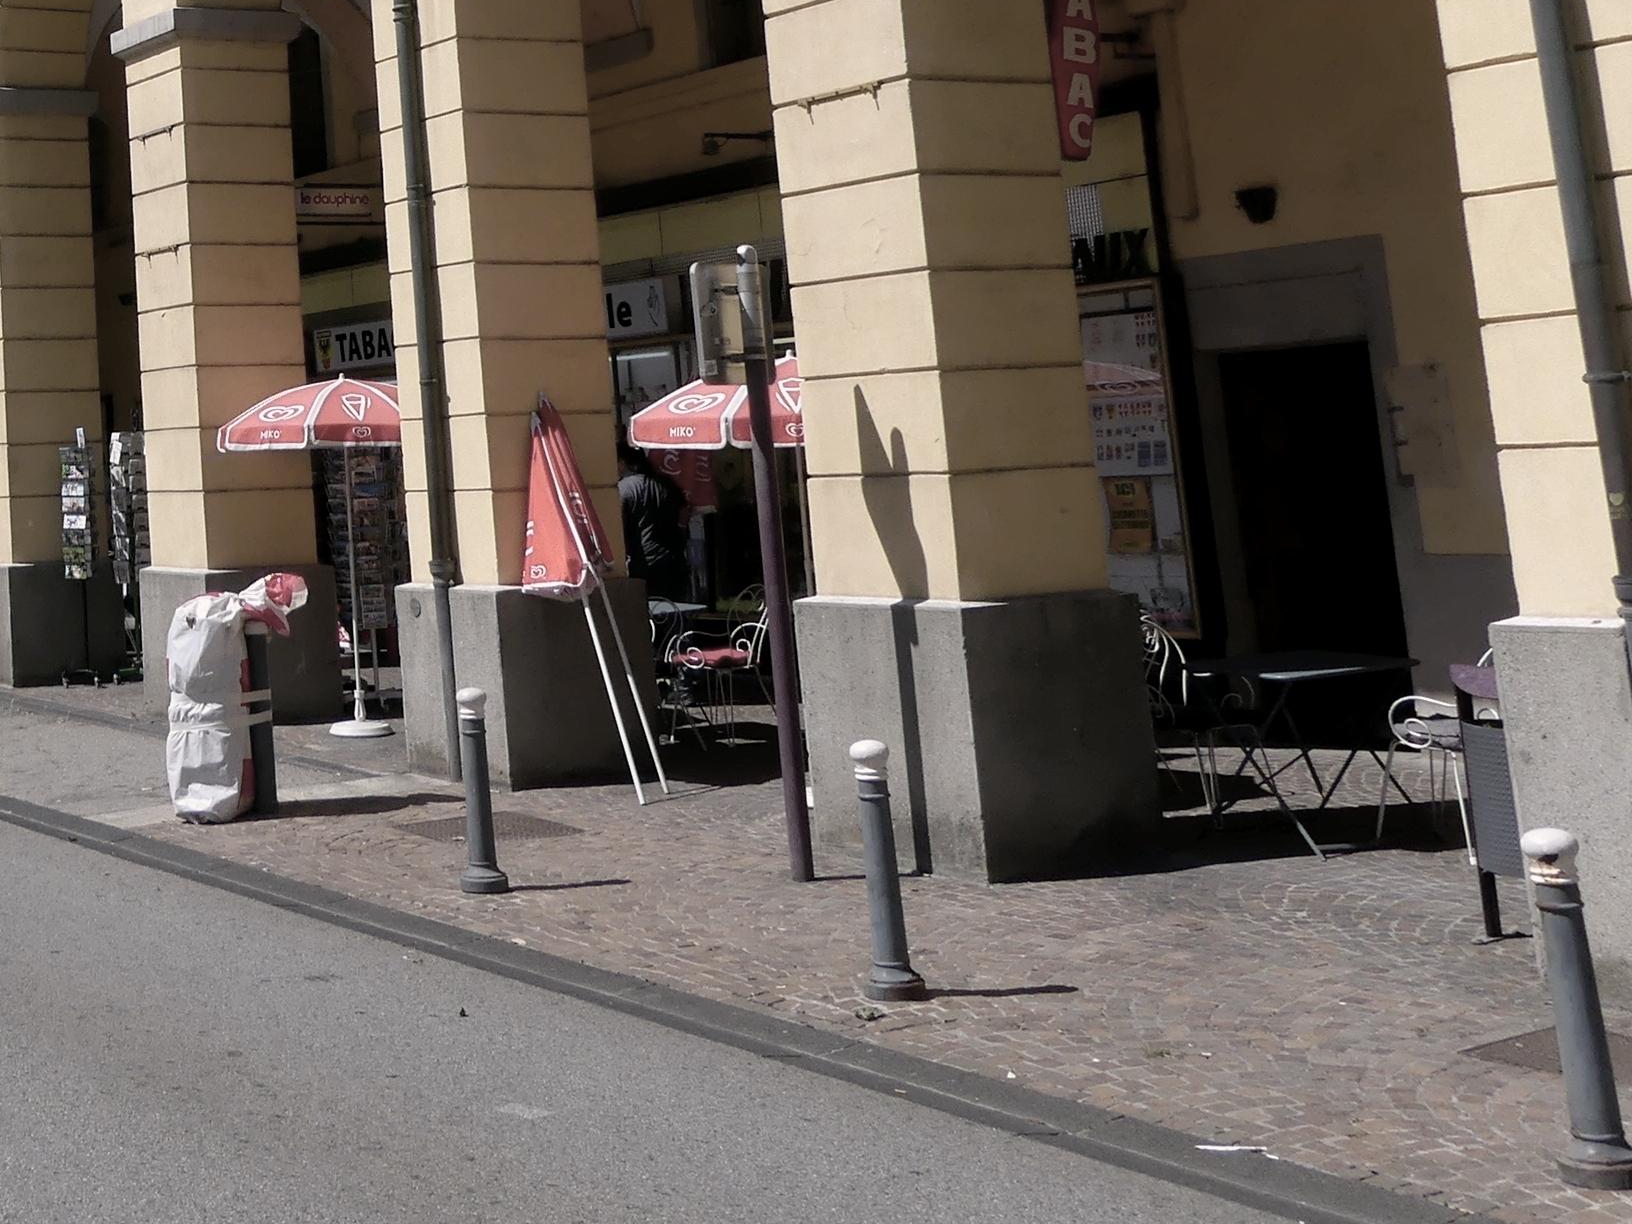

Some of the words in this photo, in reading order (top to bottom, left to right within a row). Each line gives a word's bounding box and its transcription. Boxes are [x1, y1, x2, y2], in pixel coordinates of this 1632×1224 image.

[606, 292, 632, 328] le
[335, 327, 393, 363] TABA
[669, 427, 695, 438] MIKO
